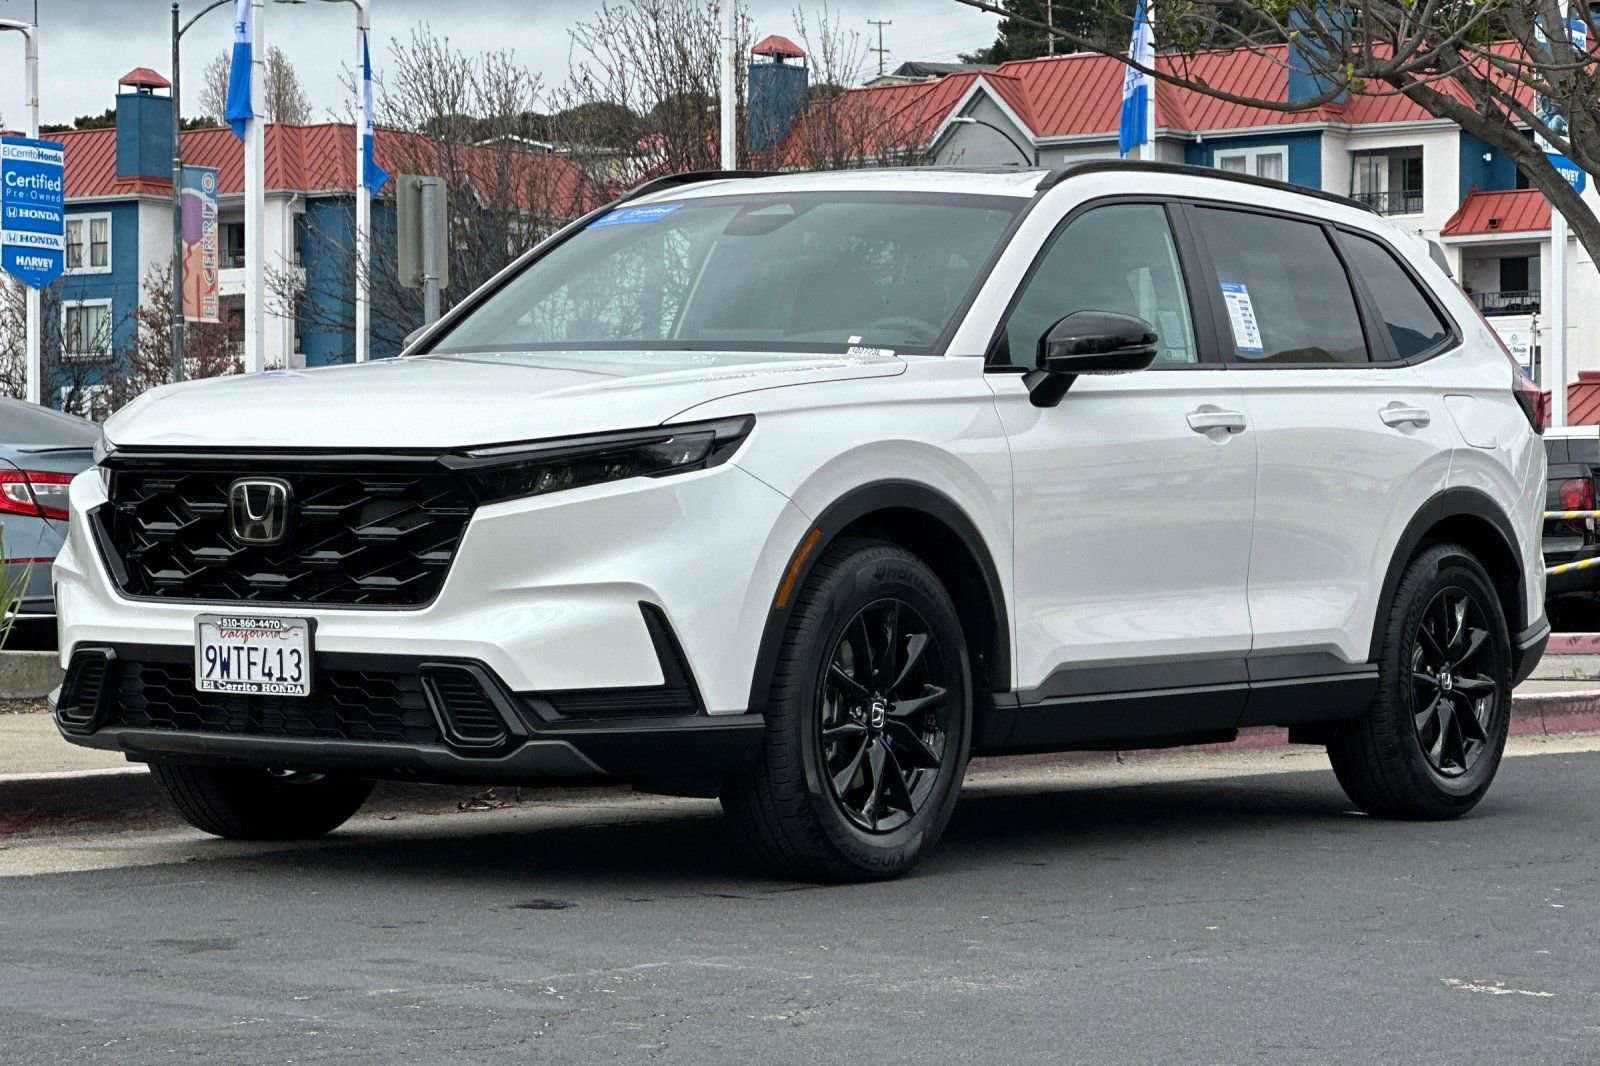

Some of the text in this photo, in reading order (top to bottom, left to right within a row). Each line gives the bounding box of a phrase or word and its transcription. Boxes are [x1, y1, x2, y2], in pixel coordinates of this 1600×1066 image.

[5, 171, 61, 192] Certified
[6, 188, 61, 203] Pre-Owned
[19, 208, 60, 222] HONDA
[202, 171, 215, 285] CERRITO
[19, 234, 59, 247] HONDA
[15, 255, 54, 269] HARVEY
[203, 294, 215, 318] EL
[222, 619, 280, 629] 510-860-4470
[220, 629, 284, 644] California
[205, 645, 302, 682] 9WTF413
[202, 680, 304, 694] El Cerrito HONDA
